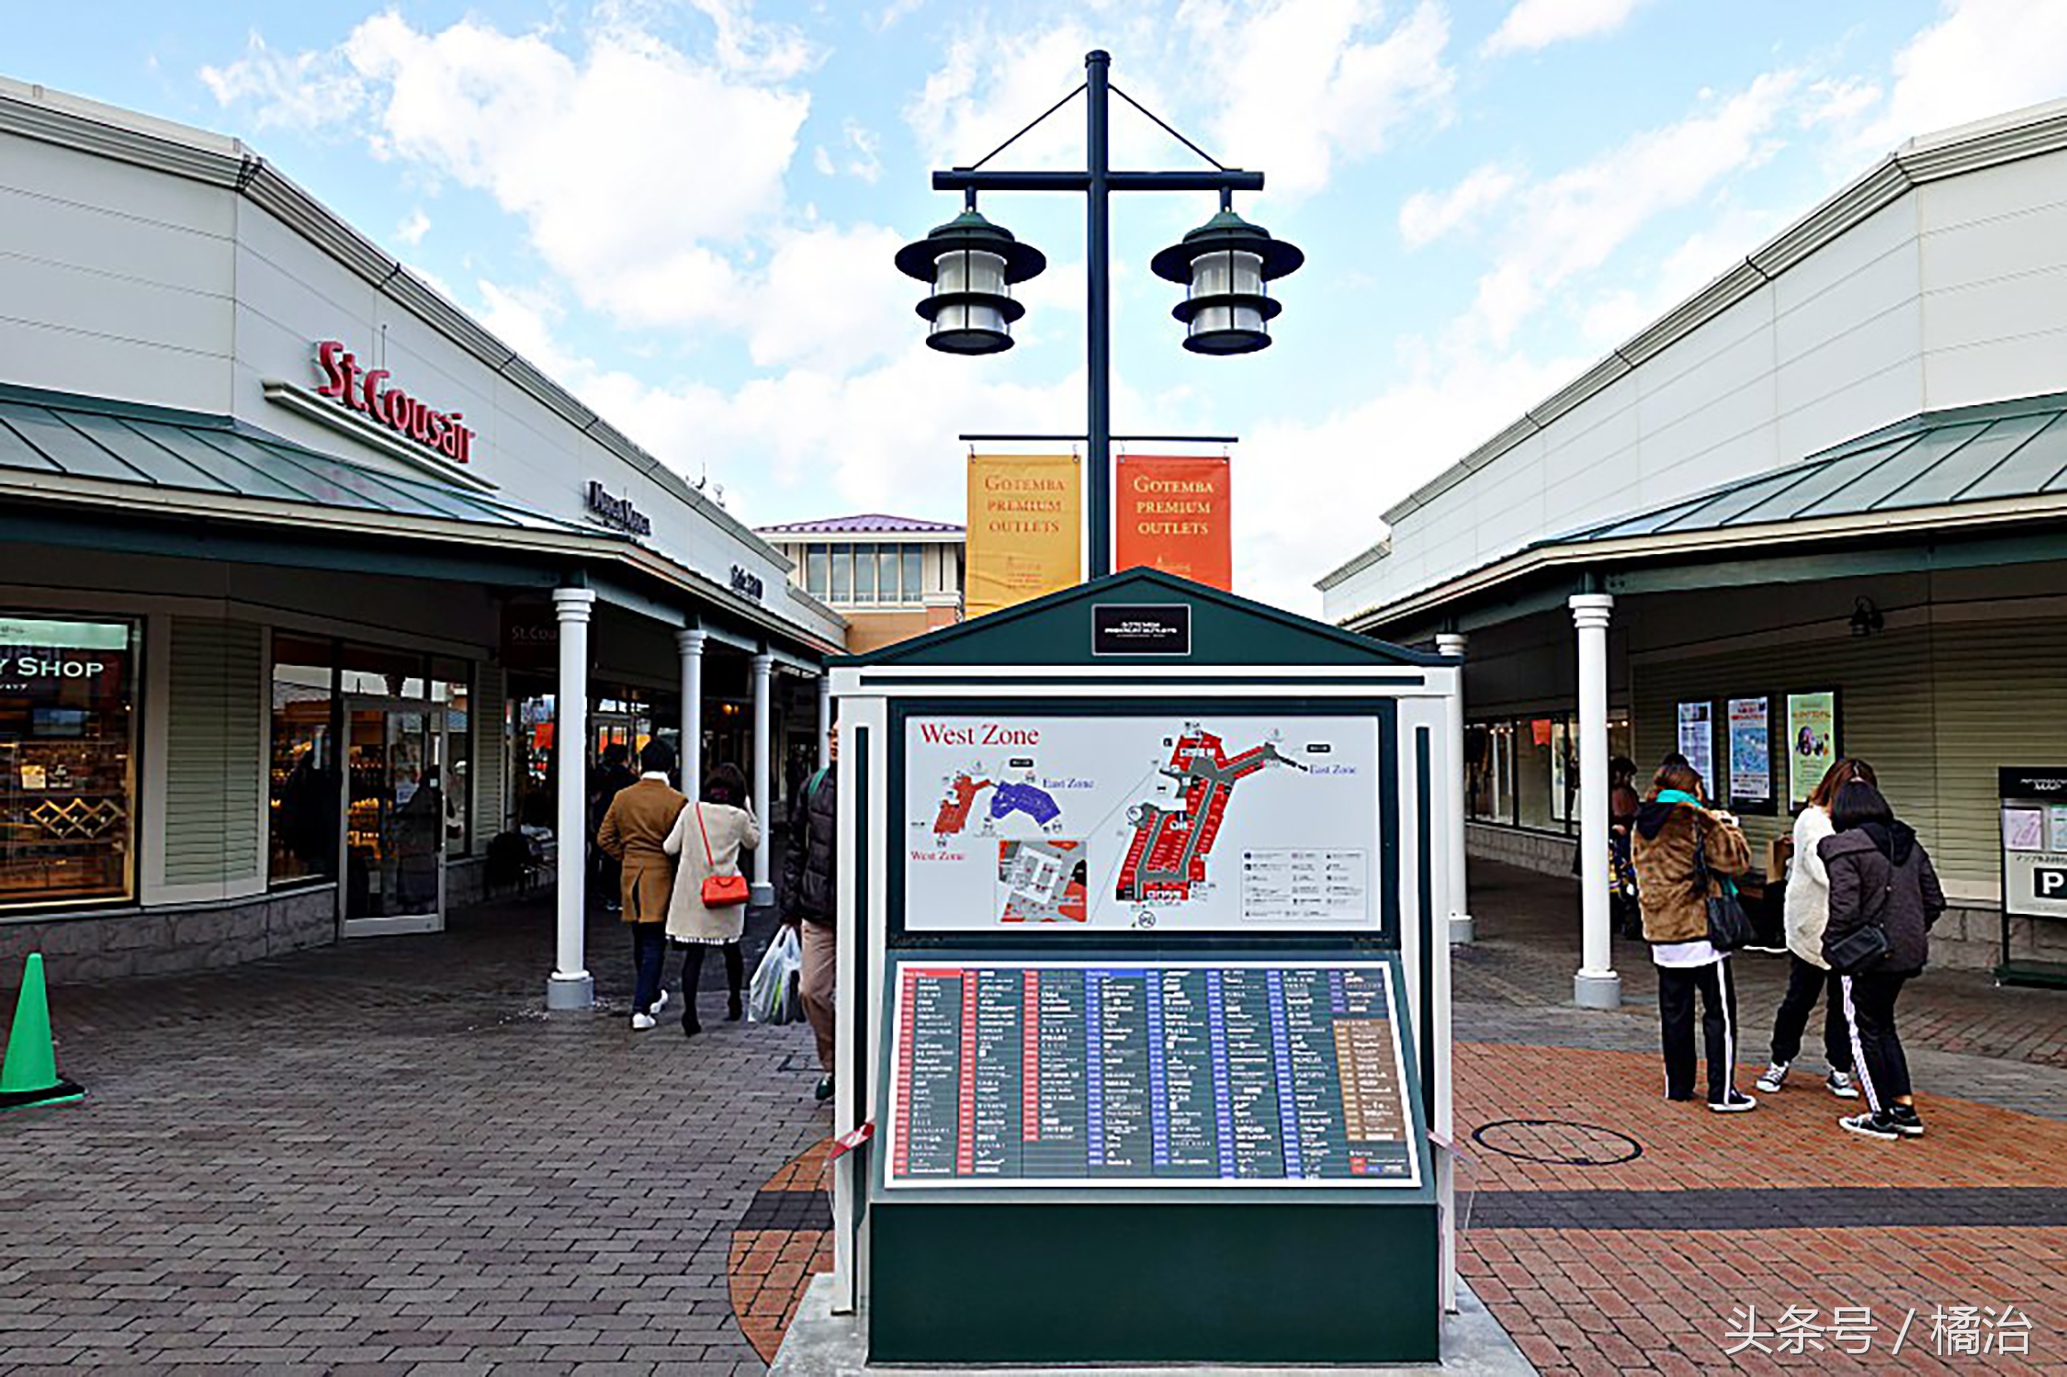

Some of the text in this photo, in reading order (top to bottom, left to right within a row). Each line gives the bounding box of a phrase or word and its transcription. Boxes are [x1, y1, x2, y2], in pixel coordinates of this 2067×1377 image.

[985, 475, 1065, 492] GOTEMBA
[1133, 475, 1214, 493] GOTEMBA
[987, 499, 1061, 512] PREMIUM
[1136, 501, 1211, 514] PREMIUM
[989, 521, 1059, 533] OUTLETS
[1138, 522, 1209, 534] OUTLETS
[511, 625, 557, 640] St.Cou
[18, 657, 104, 677] SHOP
[920, 723, 1040, 745] West Zone
